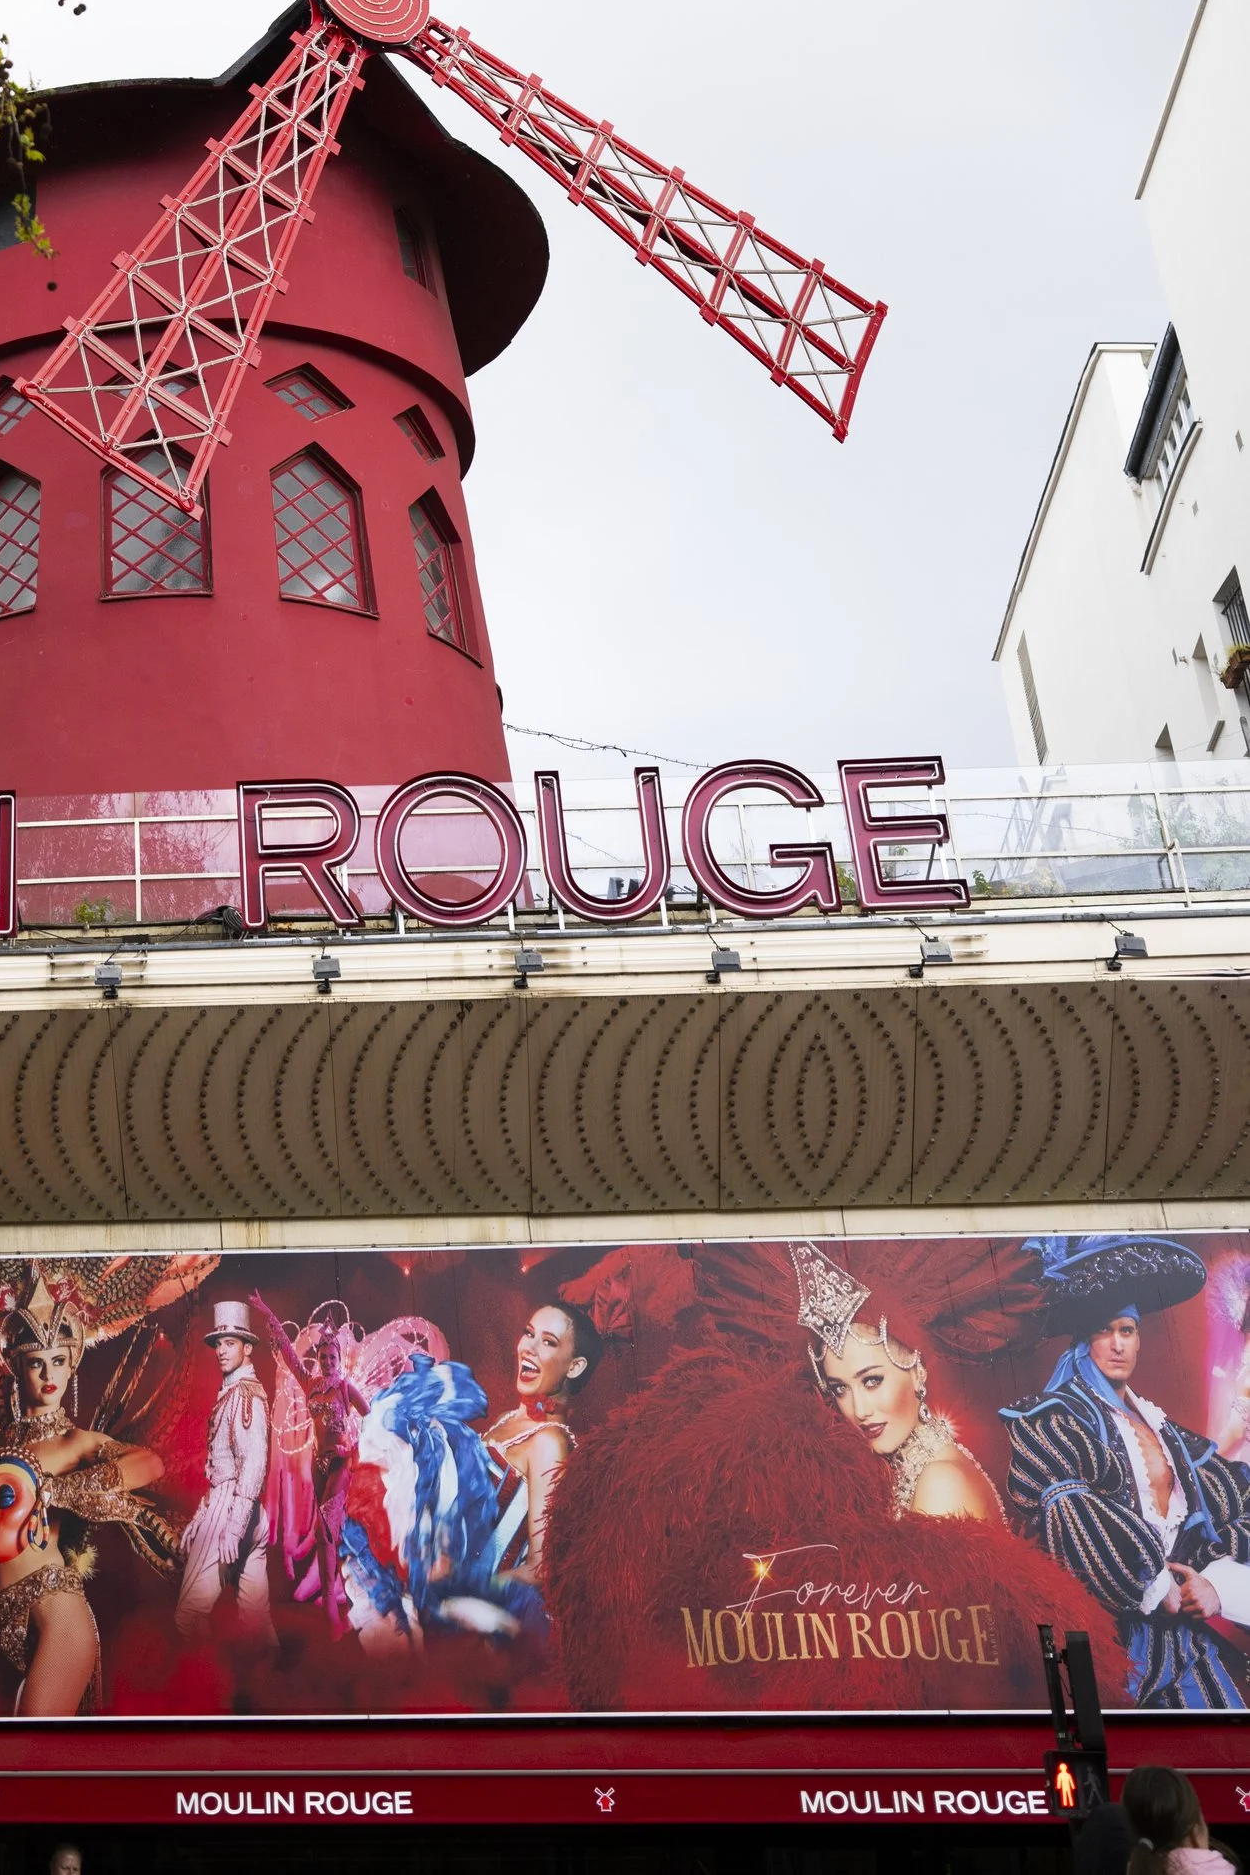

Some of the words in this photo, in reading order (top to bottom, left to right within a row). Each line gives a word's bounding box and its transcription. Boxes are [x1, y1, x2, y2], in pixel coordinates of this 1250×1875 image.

[236, 755, 971, 931] ROUGE
[726, 1544, 929, 1629] Forever
[680, 1607, 840, 1668] MOULIN
[846, 1604, 999, 1666] ROUGE
[176, 1790, 295, 1815] MOULIN
[304, 1790, 414, 1815] ROUGE
[800, 1790, 925, 1815] MOULIN
[934, 1790, 1049, 1815] ROUGE
